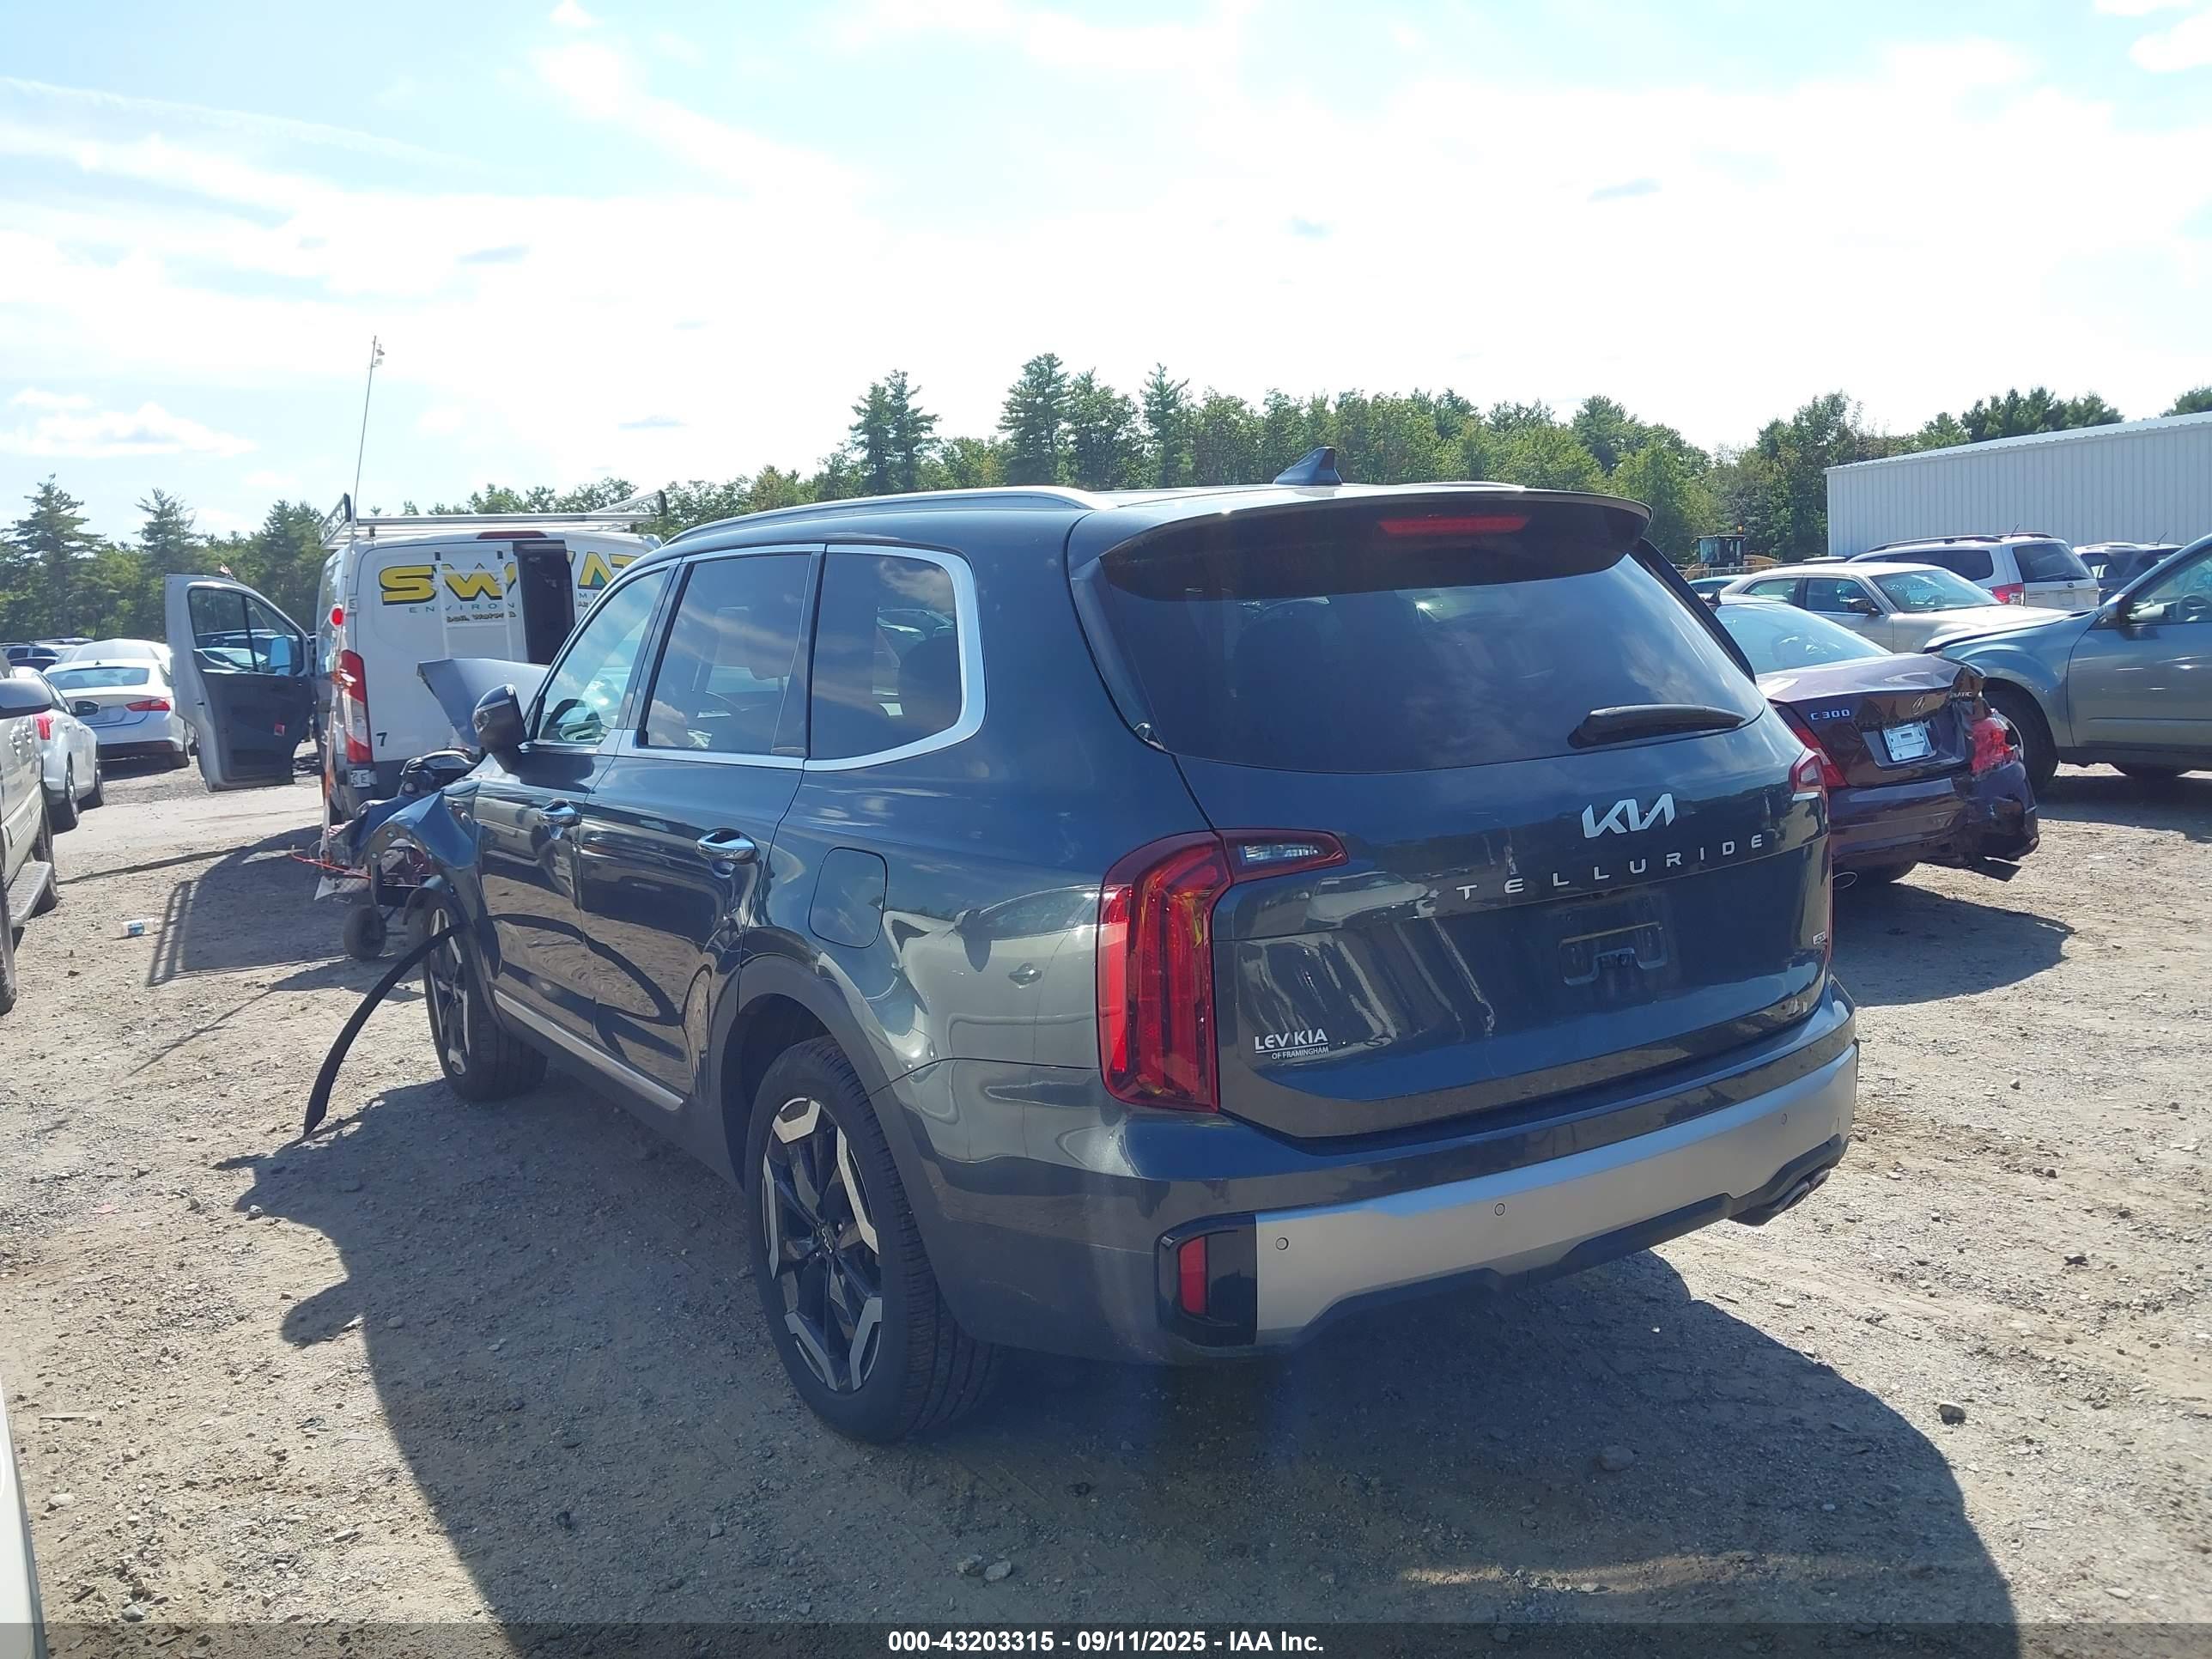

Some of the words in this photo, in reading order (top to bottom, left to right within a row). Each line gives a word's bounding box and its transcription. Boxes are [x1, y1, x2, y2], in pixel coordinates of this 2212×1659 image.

[376, 732, 387, 747] 7
[1582, 793, 1675, 839] KIA
[1455, 834, 1762, 901] TELLURIDE
[1254, 1032, 1290, 1050] LEV
[1294, 1028, 1328, 1046] KIA
[1271, 1052, 1282, 1060] OF
[1283, 1046, 1329, 1059] FRAMINGHAM
